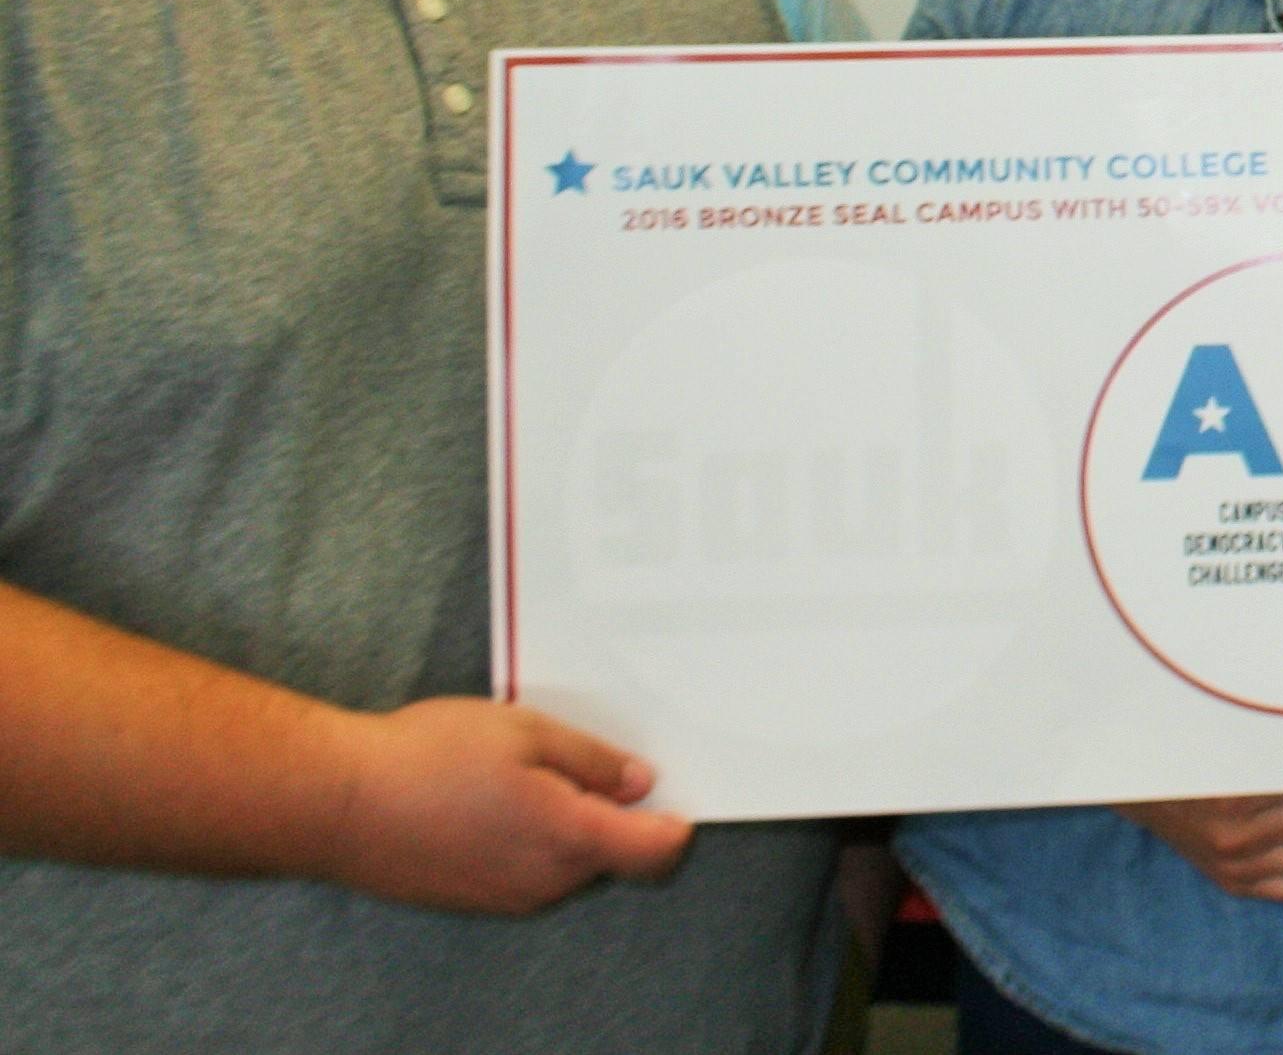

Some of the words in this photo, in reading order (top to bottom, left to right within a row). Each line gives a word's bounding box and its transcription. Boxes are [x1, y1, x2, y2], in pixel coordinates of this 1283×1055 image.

[614, 165, 710, 191] SAUK
[724, 162, 855, 188] VALLEY
[868, 156, 1093, 185] COMMUNITY
[1106, 152, 1267, 180] COLLEGE
[623, 208, 688, 231] 2016
[699, 205, 821, 229] BRONZE
[834, 204, 905, 225] SEAL
[916, 200, 1041, 223] CAMPUS
[1052, 198, 1126, 219] WITH
[1137, 194, 1243, 219] 50-59%
